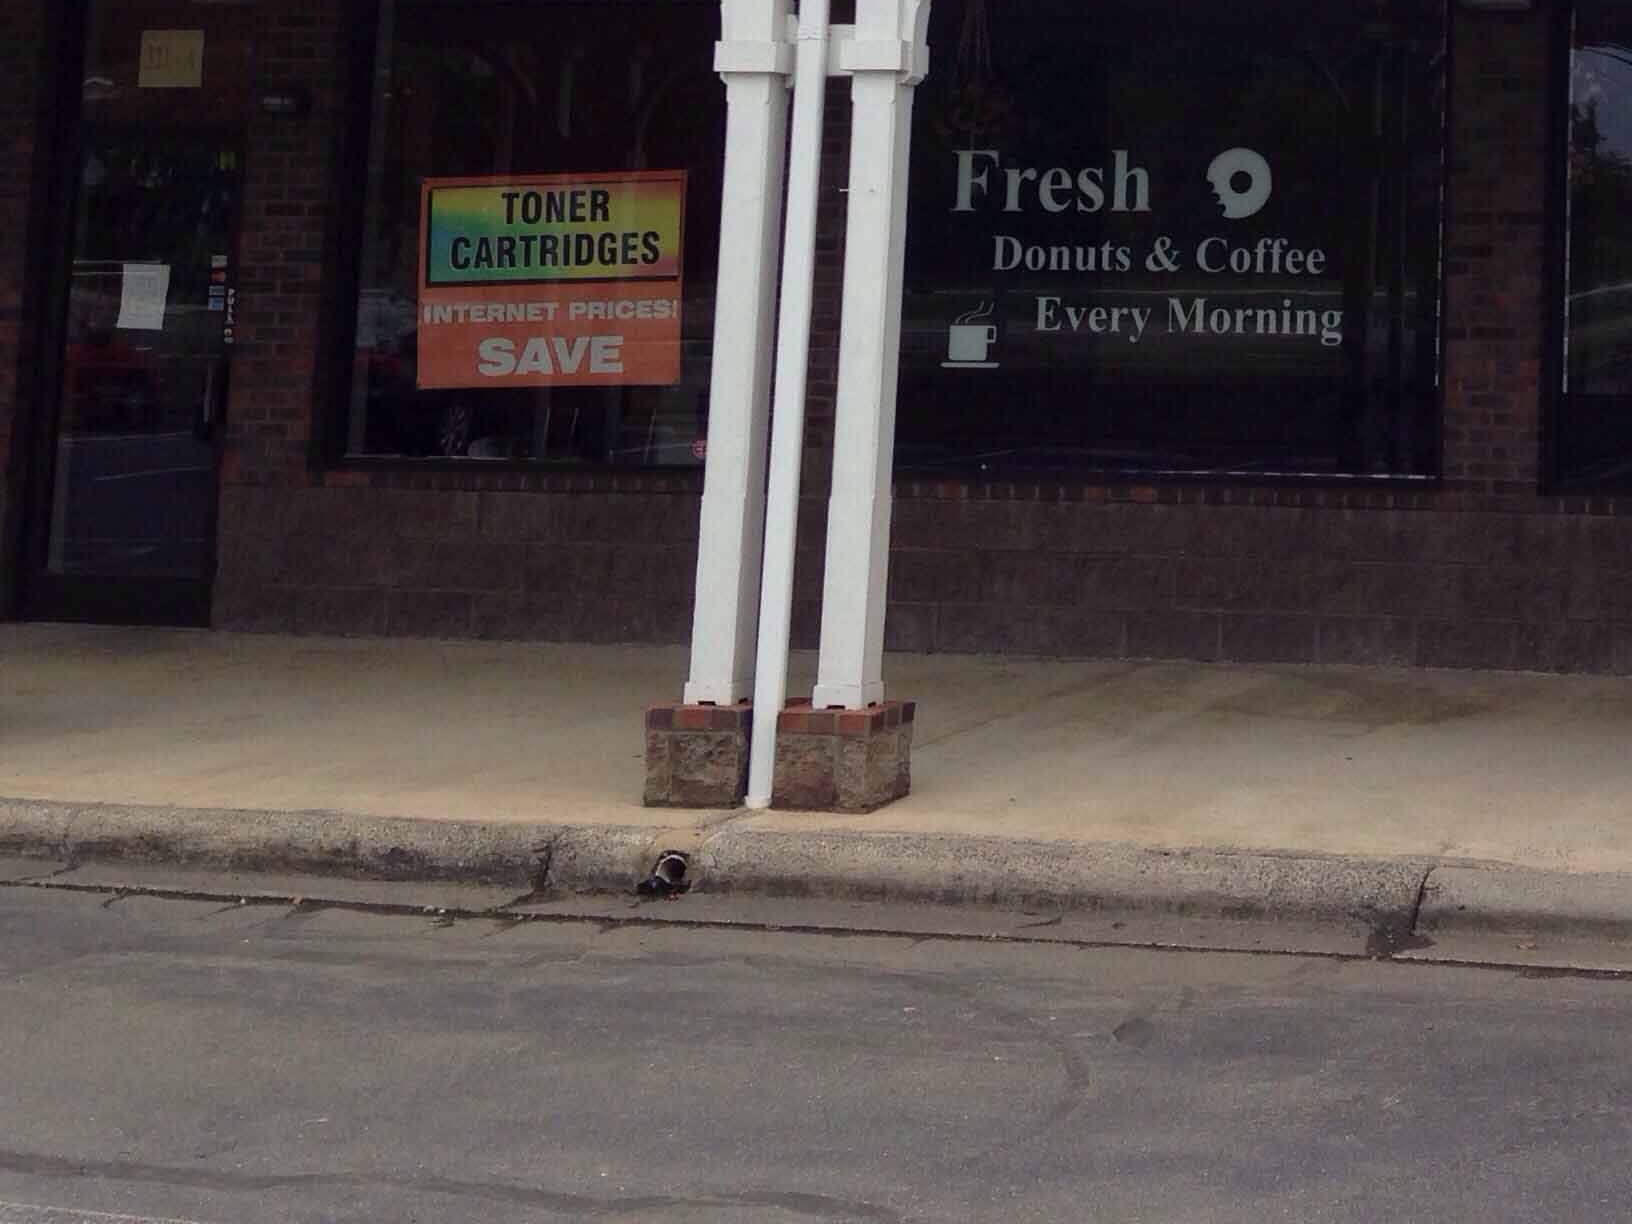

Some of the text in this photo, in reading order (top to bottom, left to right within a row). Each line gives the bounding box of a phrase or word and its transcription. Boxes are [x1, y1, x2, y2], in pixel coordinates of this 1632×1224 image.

[949, 148, 1152, 213] Fresh
[501, 189, 609, 224] TONER
[450, 231, 661, 270] CARTRIDGES
[992, 234, 1327, 274] Donuts & Coffee
[422, 298, 677, 324] INTERNET PRICES!
[1034, 295, 1343, 346] Every Morning
[477, 334, 624, 377] SAVE
